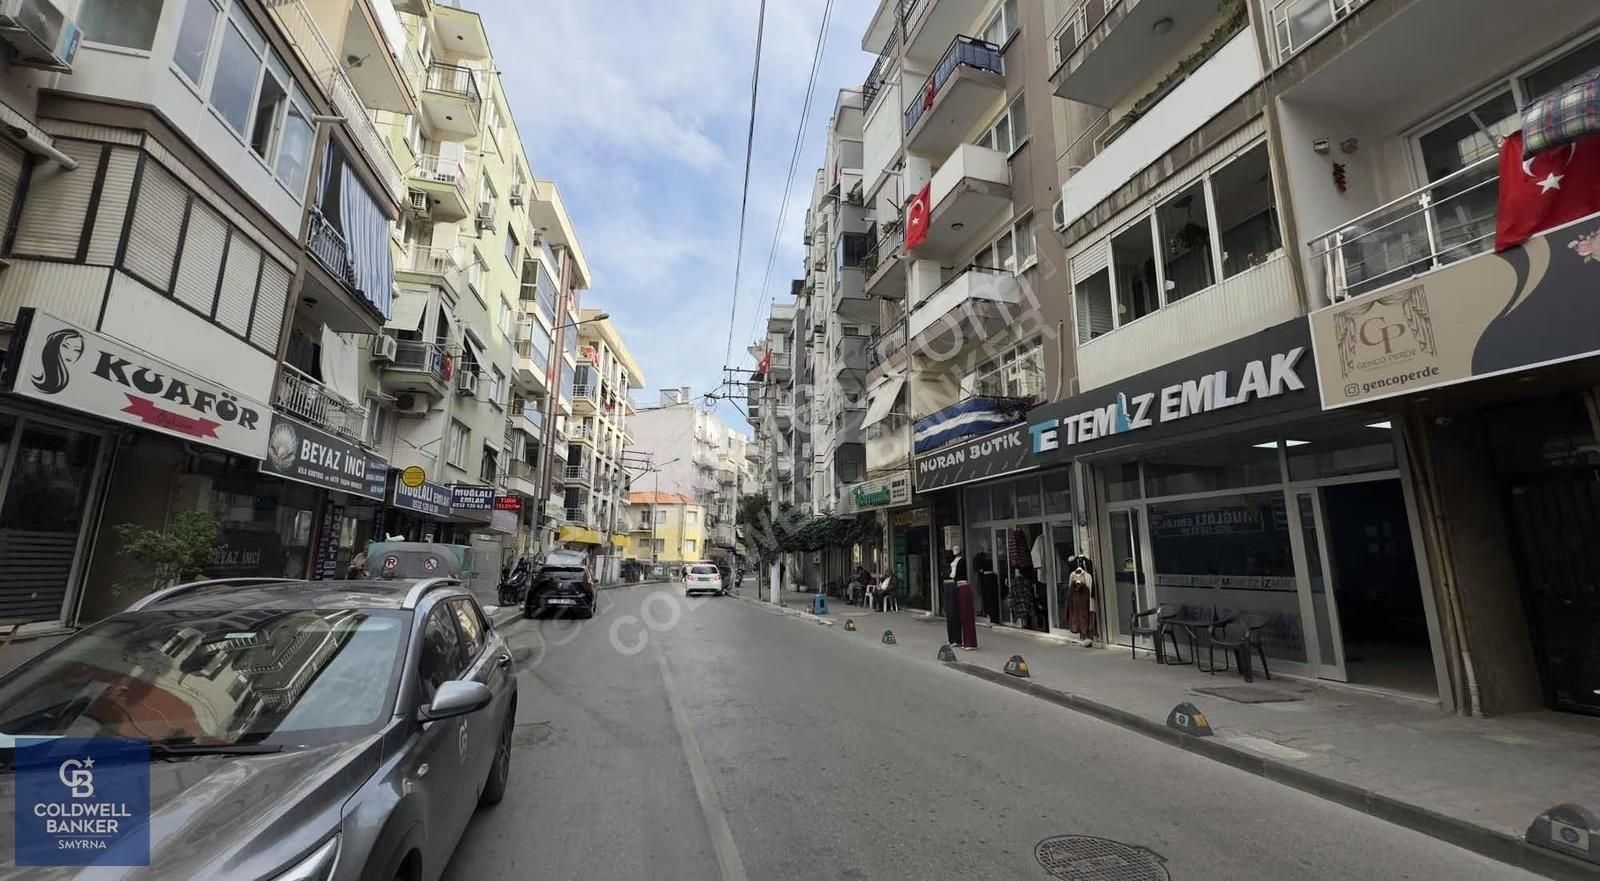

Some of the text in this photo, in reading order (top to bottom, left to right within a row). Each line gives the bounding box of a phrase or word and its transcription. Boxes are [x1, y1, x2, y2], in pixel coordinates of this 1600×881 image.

[1160, 347, 1305, 422] EMLAK
[1362, 366, 1440, 393] gencoperde
[300, 439, 341, 471] BEYAZ
[344, 449, 366, 479] İNCİ
[920, 450, 965, 473] NURAN
[460, 496, 485, 504] EMLAK
